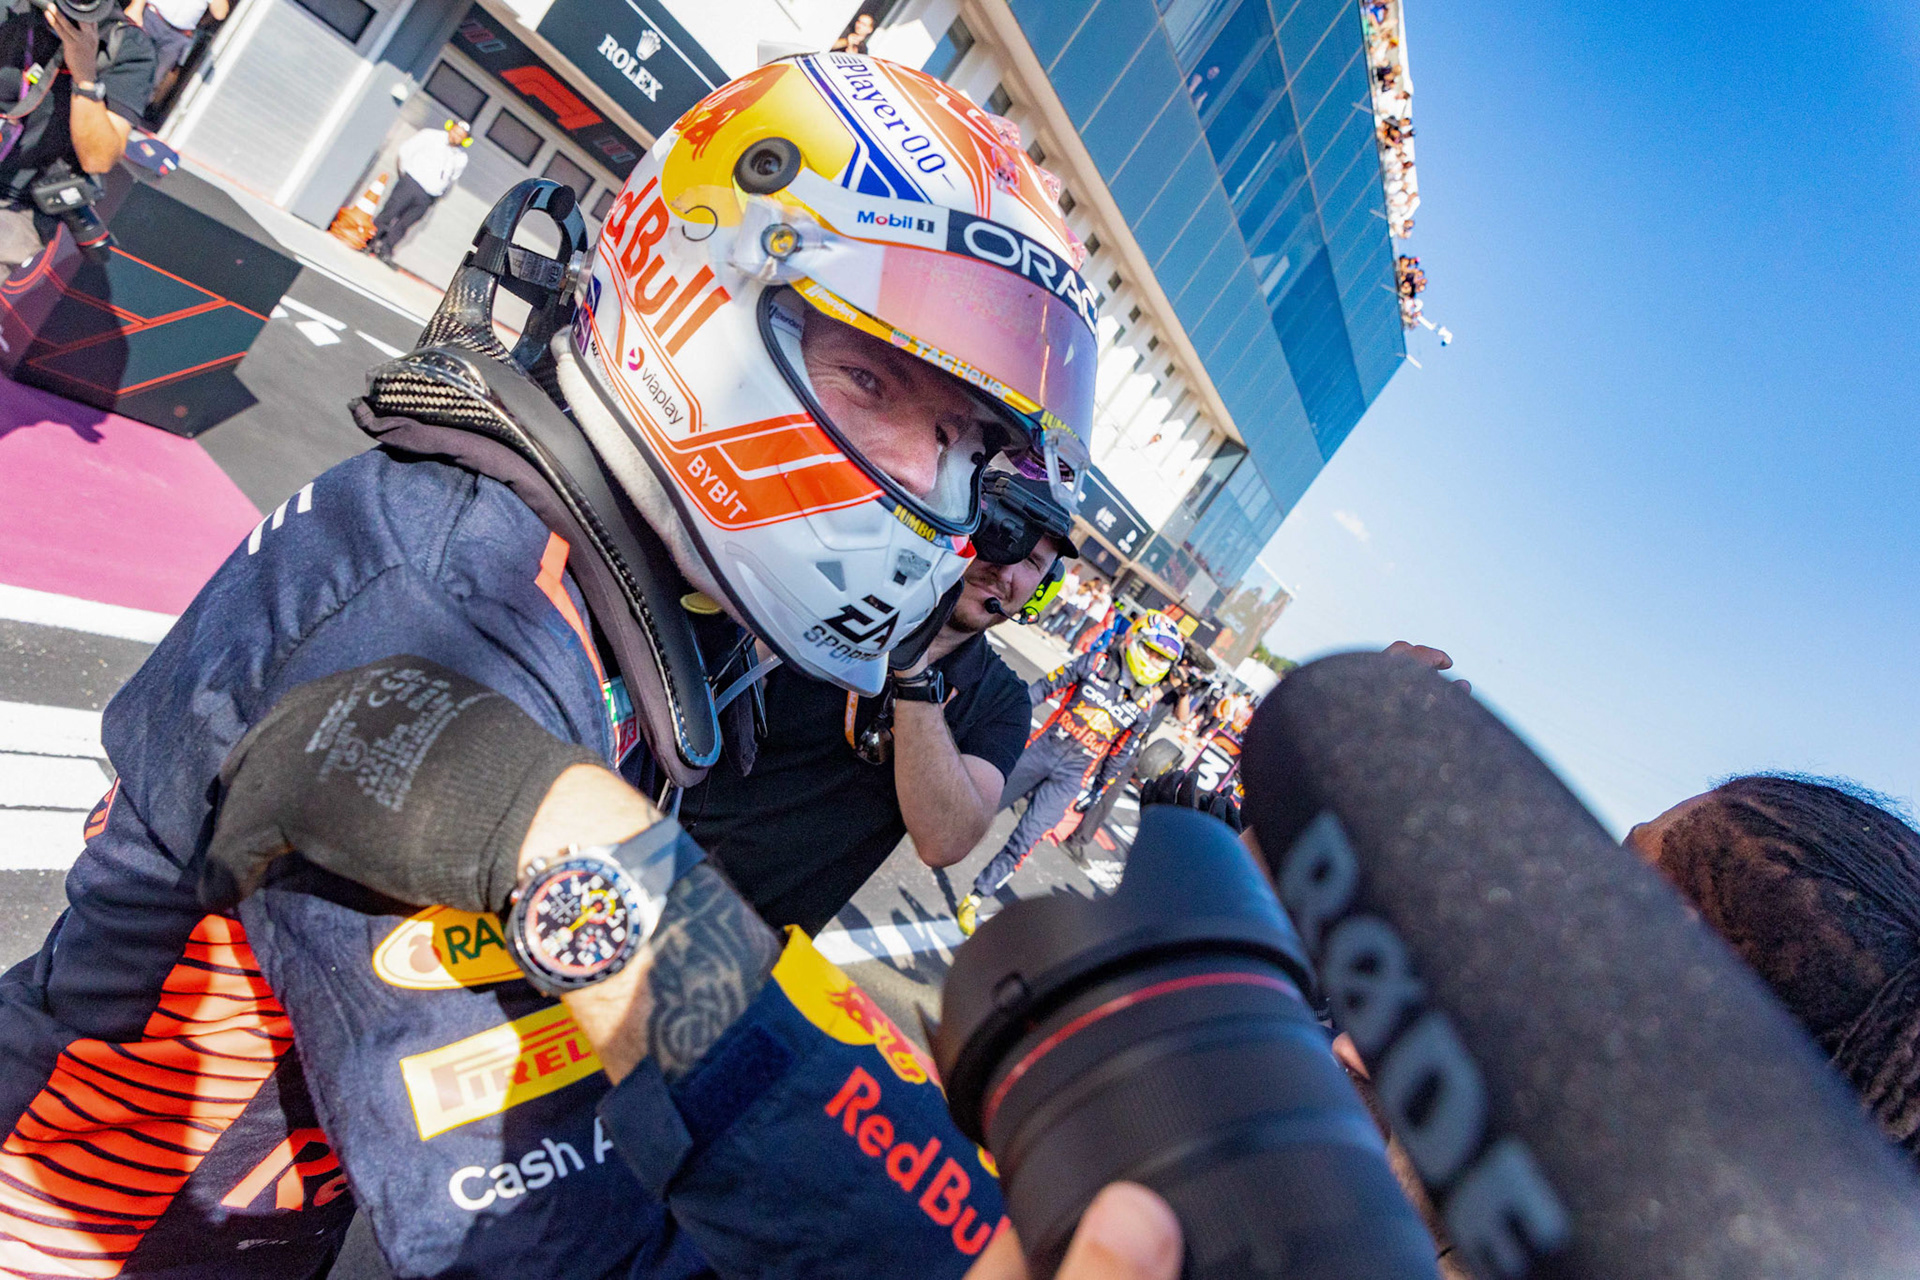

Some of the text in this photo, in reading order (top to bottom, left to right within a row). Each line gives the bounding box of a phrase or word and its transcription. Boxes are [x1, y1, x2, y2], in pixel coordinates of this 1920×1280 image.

[598, 33, 663, 102] ROLEX
[836, 63, 911, 131] Player
[857, 210, 913, 230] Mobil
[620, 196, 732, 357] Bull
[964, 221, 1099, 334] ORAC
[642, 367, 684, 425] viaplay
[687, 454, 748, 519] BYBIT
[893, 505, 937, 542] JUMBO
[823, 594, 900, 650] EA
[1196, 748, 1230, 792] 3
[444, 918, 506, 965] RA
[431, 1018, 592, 1112] PIREL
[824, 1065, 942, 1192] Red
[448, 1137, 586, 1211] Cash
